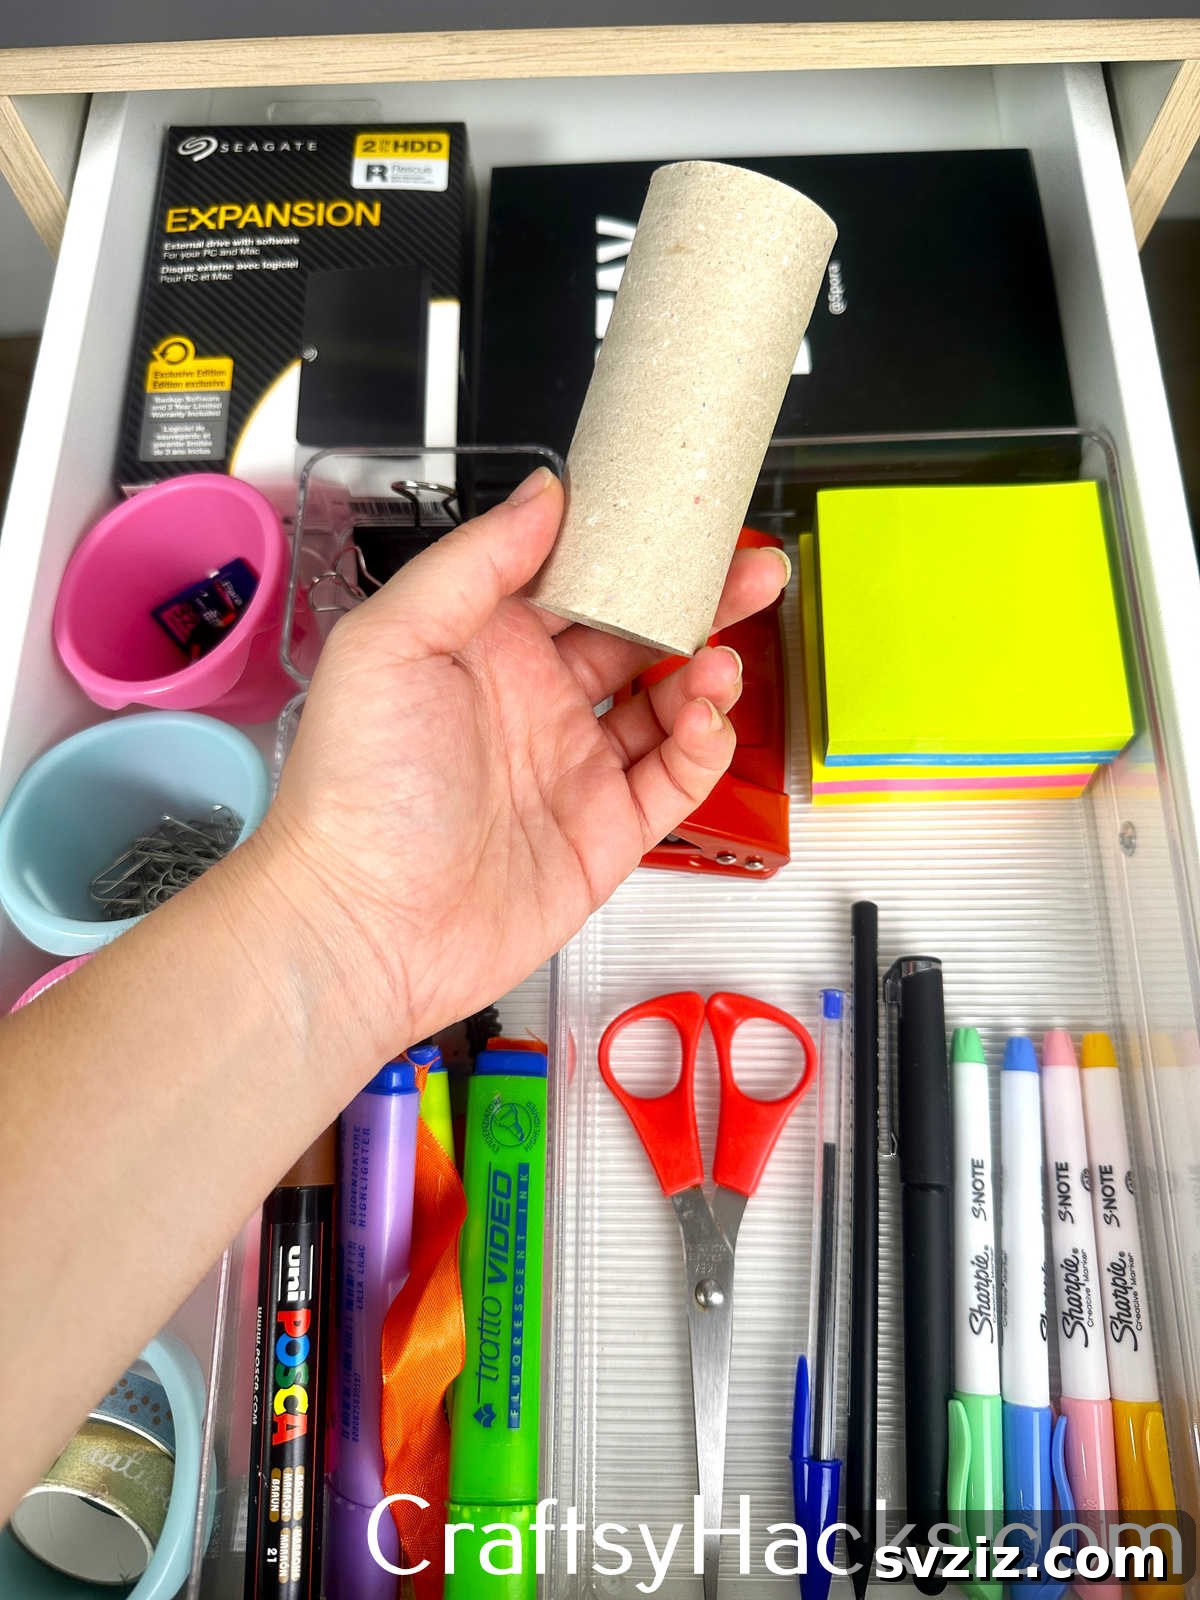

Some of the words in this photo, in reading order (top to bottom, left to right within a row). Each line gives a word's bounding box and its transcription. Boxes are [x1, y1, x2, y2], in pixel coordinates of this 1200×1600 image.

[219, 141, 318, 154] SEAGATE
[393, 140, 443, 153] HDD
[165, 200, 382, 233] EXPANSION
[163, 252, 178, 260] For
[180, 251, 201, 261] your
[203, 249, 218, 257] PC
[219, 248, 238, 257] and
[239, 247, 261, 256] Mac
[164, 240, 205, 251] External
[206, 239, 231, 249] drive
[231, 238, 254, 247] with
[255, 236, 300, 246] software
[160, 275, 181, 283] Pour
[183, 274, 199, 282] PC
[212, 272, 233, 281] Mac
[161, 264, 195, 275] Disque
[196, 262, 235, 273] externe
[236, 261, 261, 271] avec
[262, 259, 299, 271] logiciel
[517, 1173, 529, 1213] INK
[488, 1169, 513, 1285] VIDEO
[286, 1245, 306, 1302] uni
[1081, 1248, 1090, 1282] Marker
[1127, 1252, 1136, 1286] Marker
[1084, 1287, 1095, 1328] Creative
[1132, 1290, 1143, 1331] Creative
[475, 1295, 502, 1382] tratto
[510, 1234, 526, 1418] FLUORESCENT
[271, 1308, 311, 1446] POSCA
[270, 1478, 280, 1512] BRAUN
[282, 1472, 292, 1517] MARRON
[266, 1547, 278, 1563] 21
